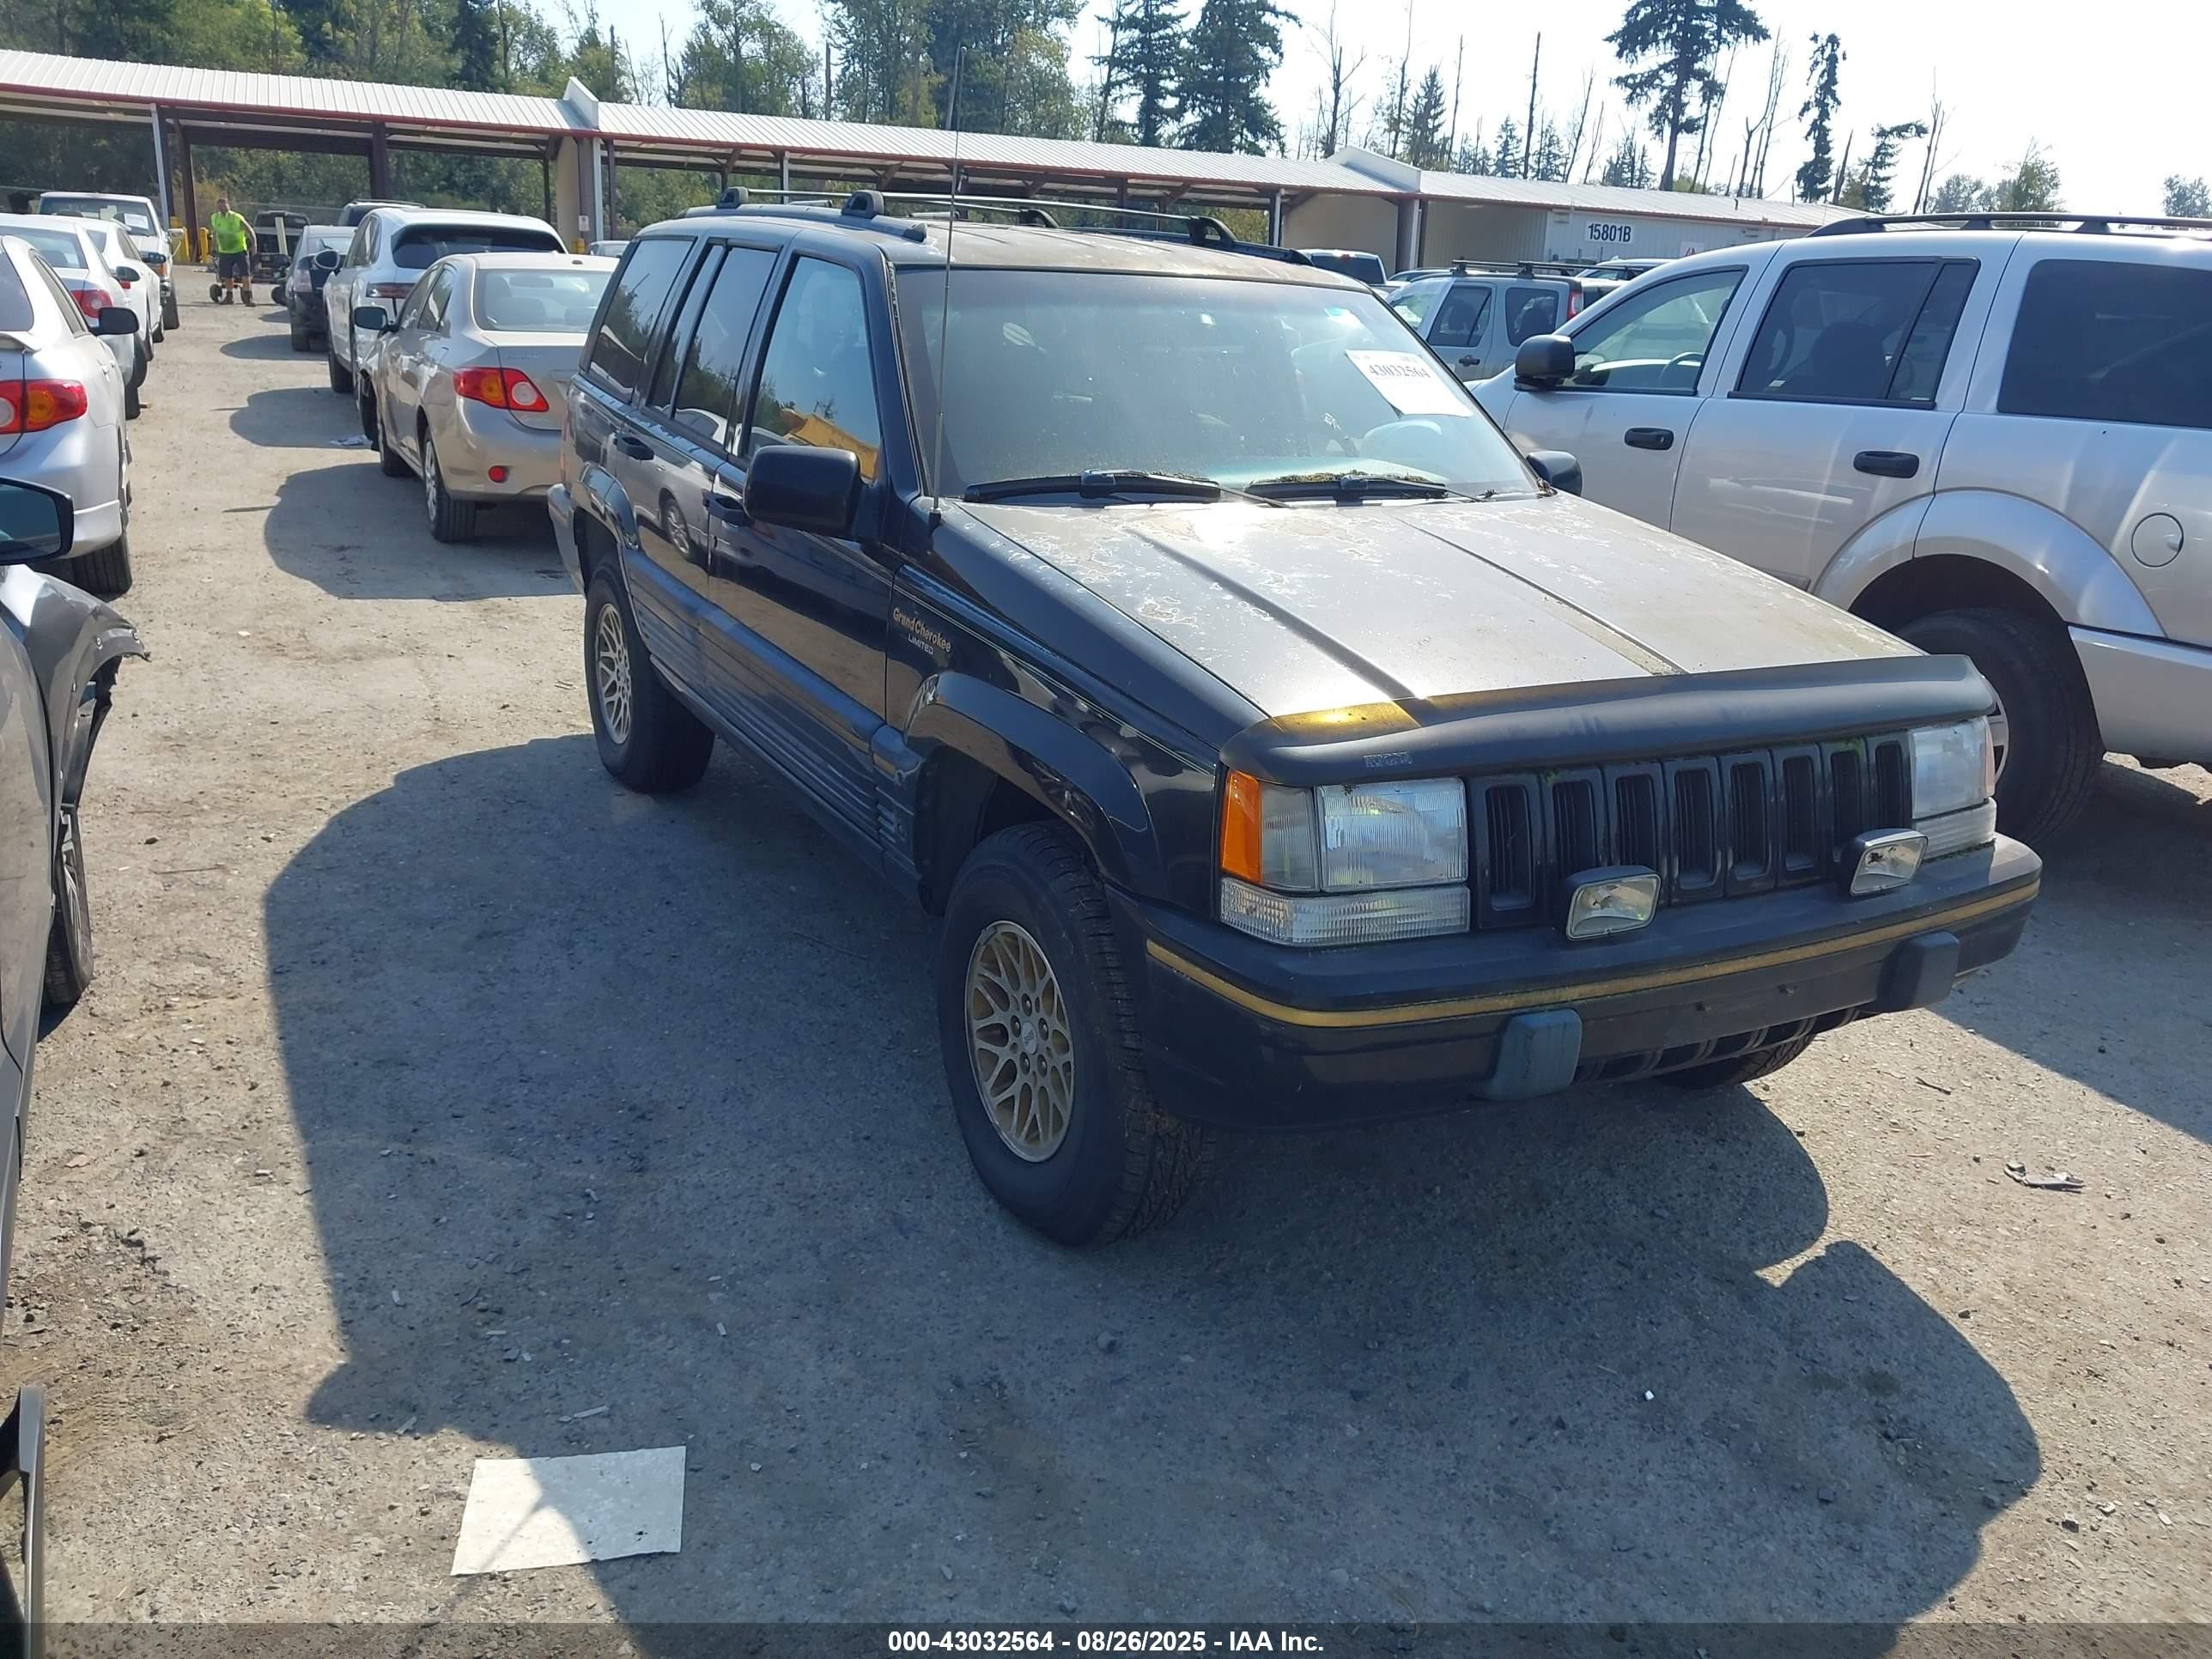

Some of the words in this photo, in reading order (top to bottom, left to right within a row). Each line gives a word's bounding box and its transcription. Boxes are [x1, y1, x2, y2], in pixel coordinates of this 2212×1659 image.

[1589, 223, 1632, 242] 15801B
[893, 607, 915, 631] Grand
[915, 620, 951, 653] Cherokee
[908, 633, 934, 654] LIMITED
